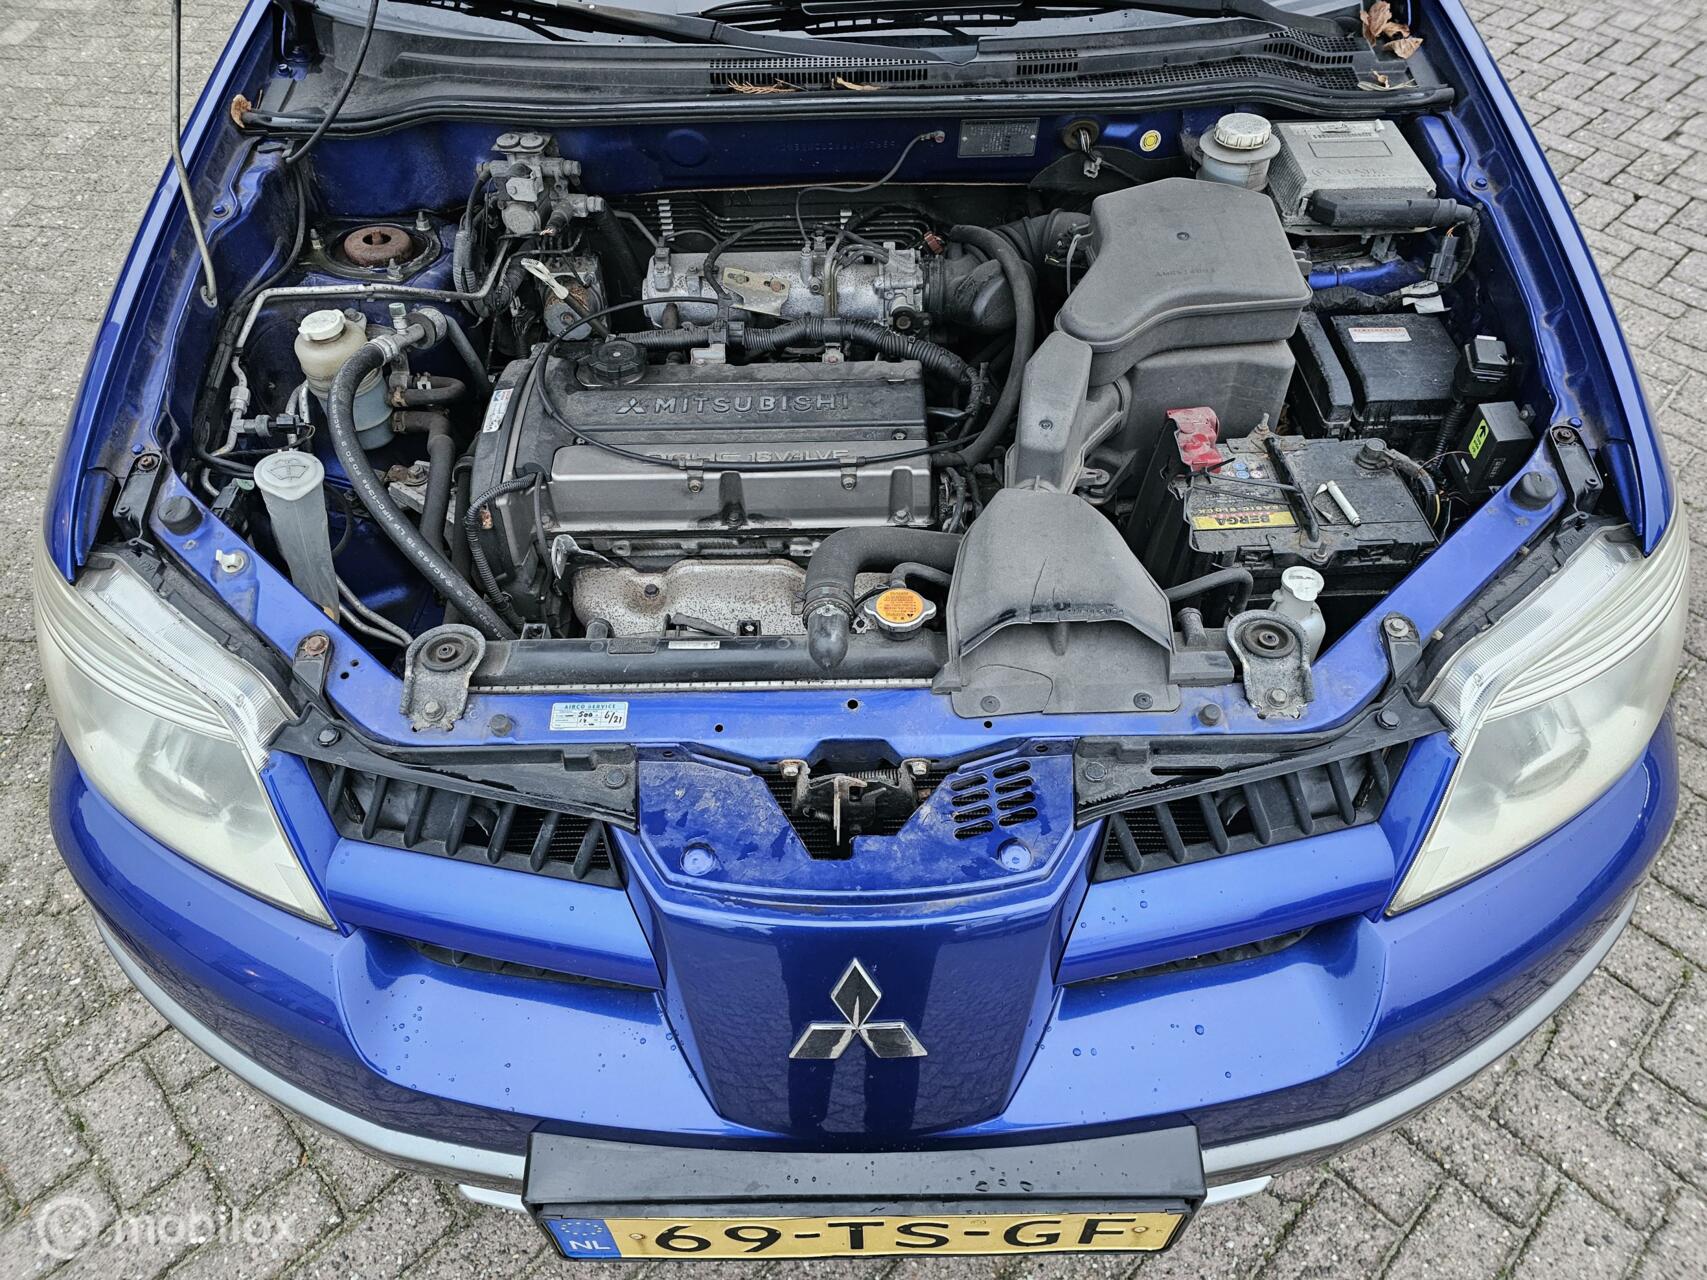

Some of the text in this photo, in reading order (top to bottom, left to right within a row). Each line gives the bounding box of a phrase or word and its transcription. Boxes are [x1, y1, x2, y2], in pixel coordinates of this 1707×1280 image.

[654, 394, 849, 413] MITSUBISHI
[1215, 514, 1270, 526] BERGA
[568, 1218, 1136, 1252] NL 69-TS-GF
